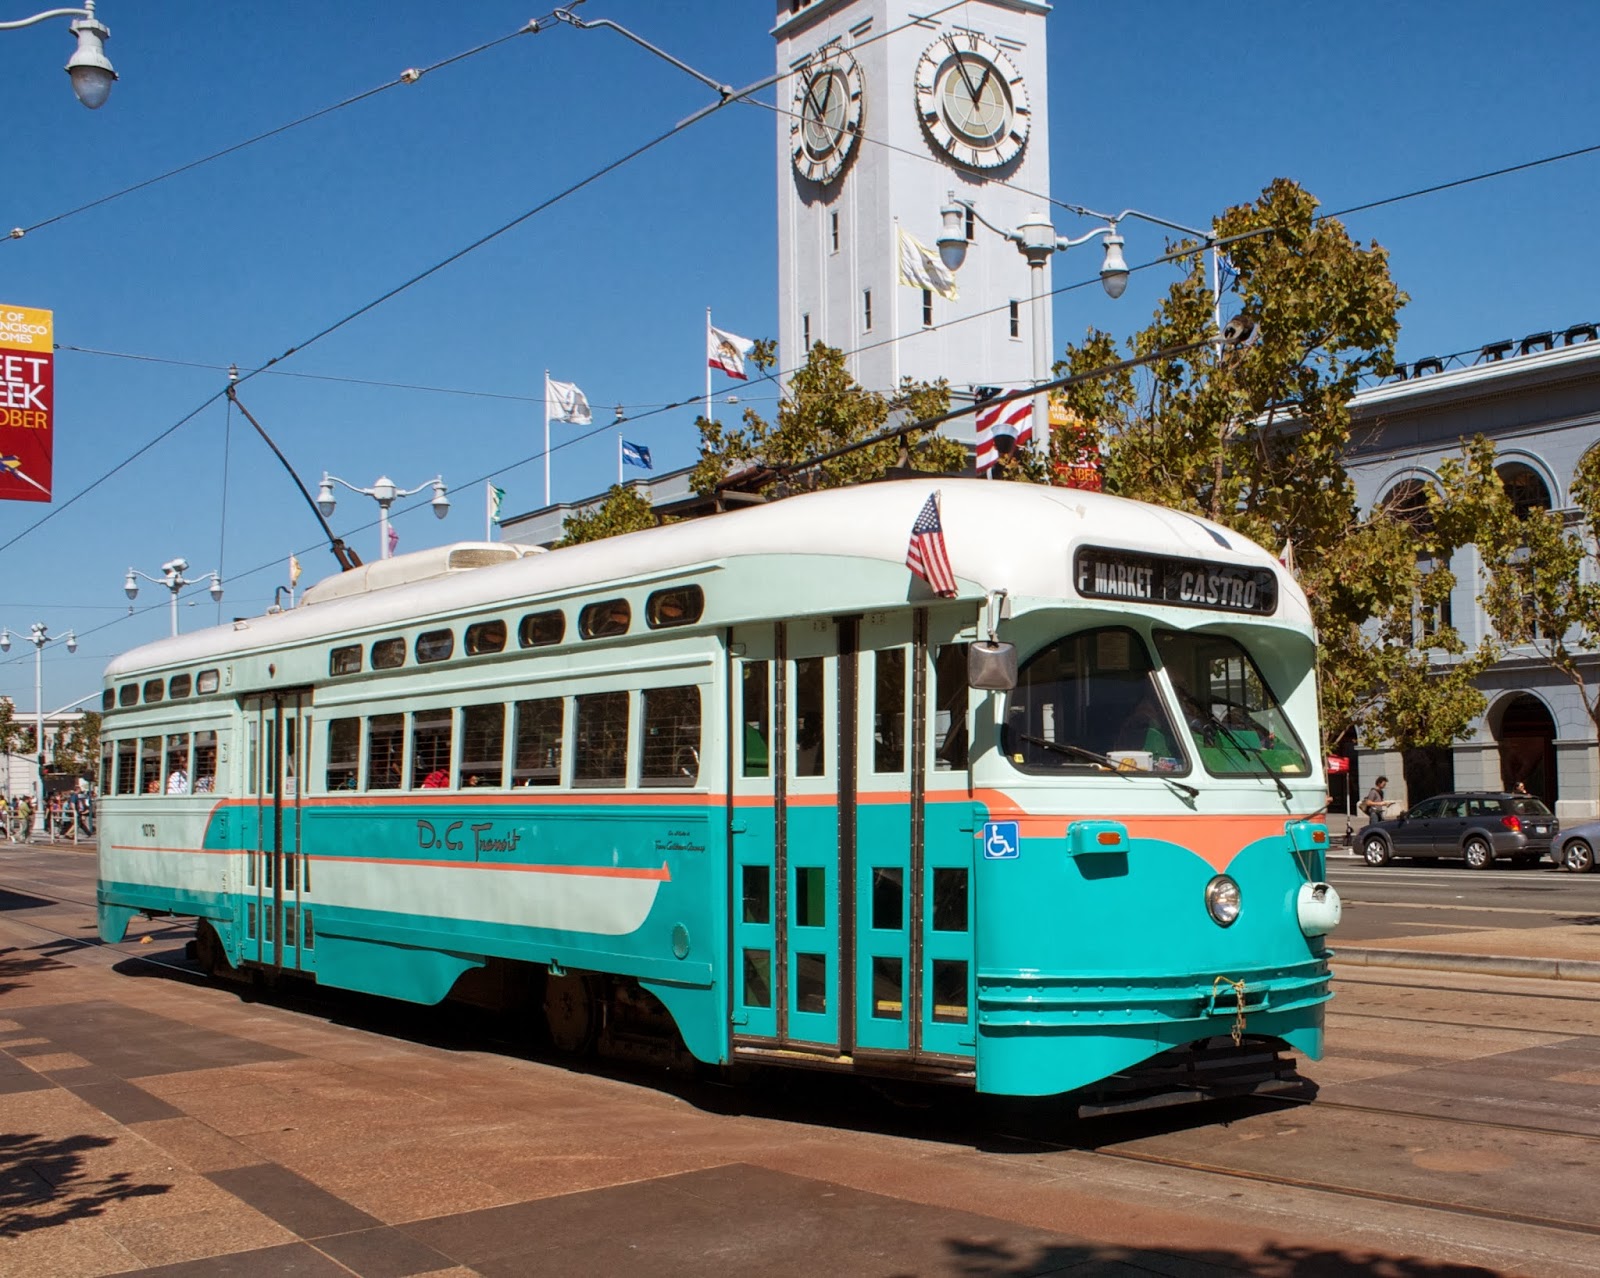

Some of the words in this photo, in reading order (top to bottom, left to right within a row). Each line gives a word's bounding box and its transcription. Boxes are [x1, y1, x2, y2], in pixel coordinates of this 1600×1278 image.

[6, 312, 25, 322] OF
[0, 331, 33, 344] OMES
[1078, 560, 1089, 591] F
[1095, 562, 1154, 598] MARKET
[1180, 572, 1257, 609] CASTRO
[470, 822, 521, 862] Transit
